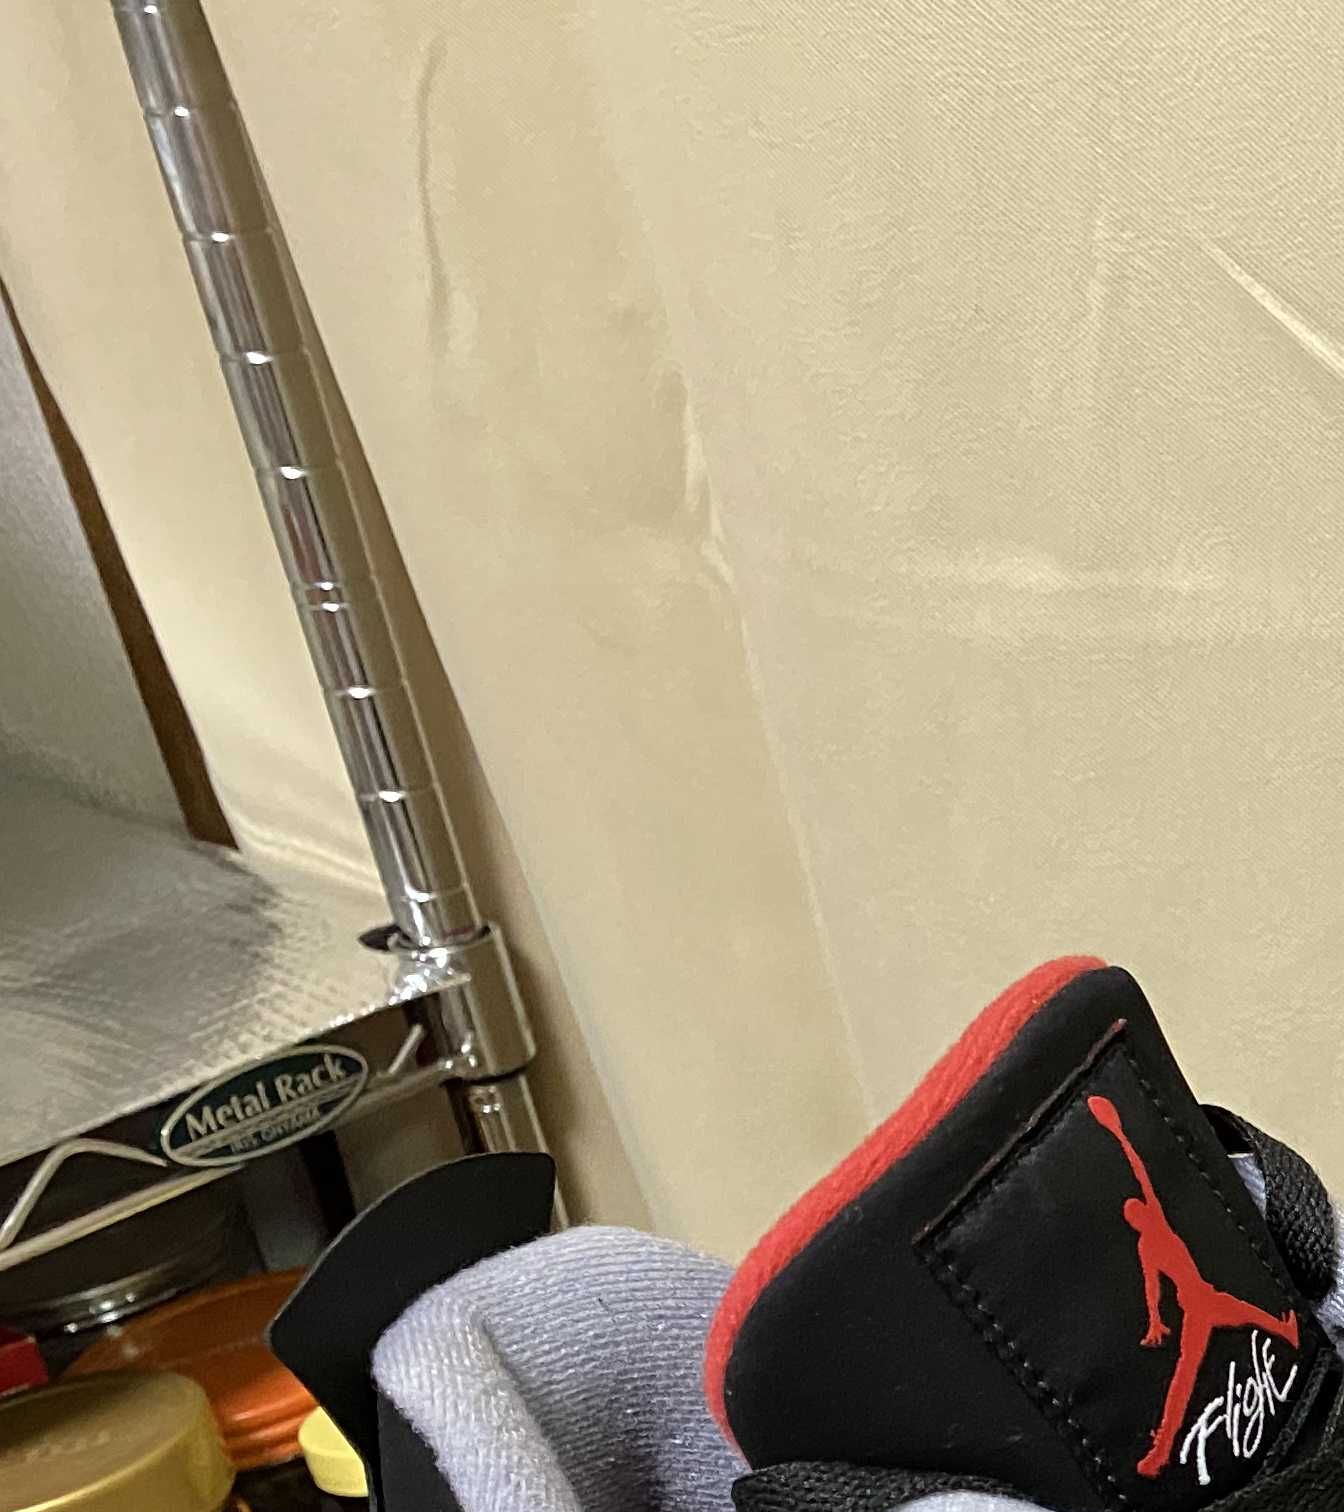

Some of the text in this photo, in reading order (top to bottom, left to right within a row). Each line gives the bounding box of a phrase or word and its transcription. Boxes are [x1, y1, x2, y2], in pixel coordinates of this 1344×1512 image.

[185, 1052, 347, 1142] Metal Rack
[1179, 1329, 1298, 1486] Flight
